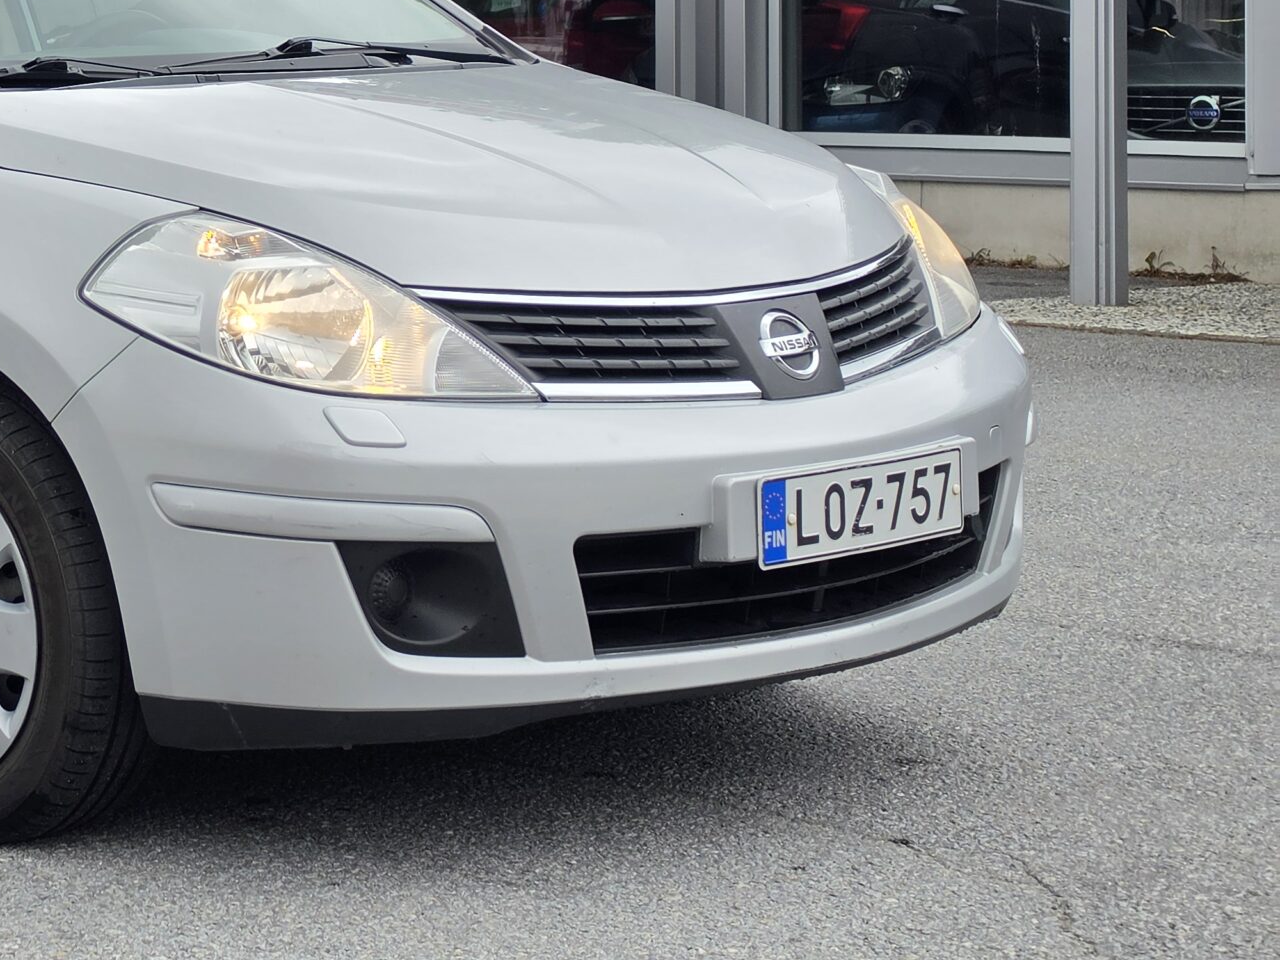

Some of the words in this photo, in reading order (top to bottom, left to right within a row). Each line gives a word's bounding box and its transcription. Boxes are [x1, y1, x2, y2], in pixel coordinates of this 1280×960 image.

[771, 332, 817, 352] NISSAN
[795, 461, 952, 547] LOZ-757
[764, 527, 786, 550] FIN
